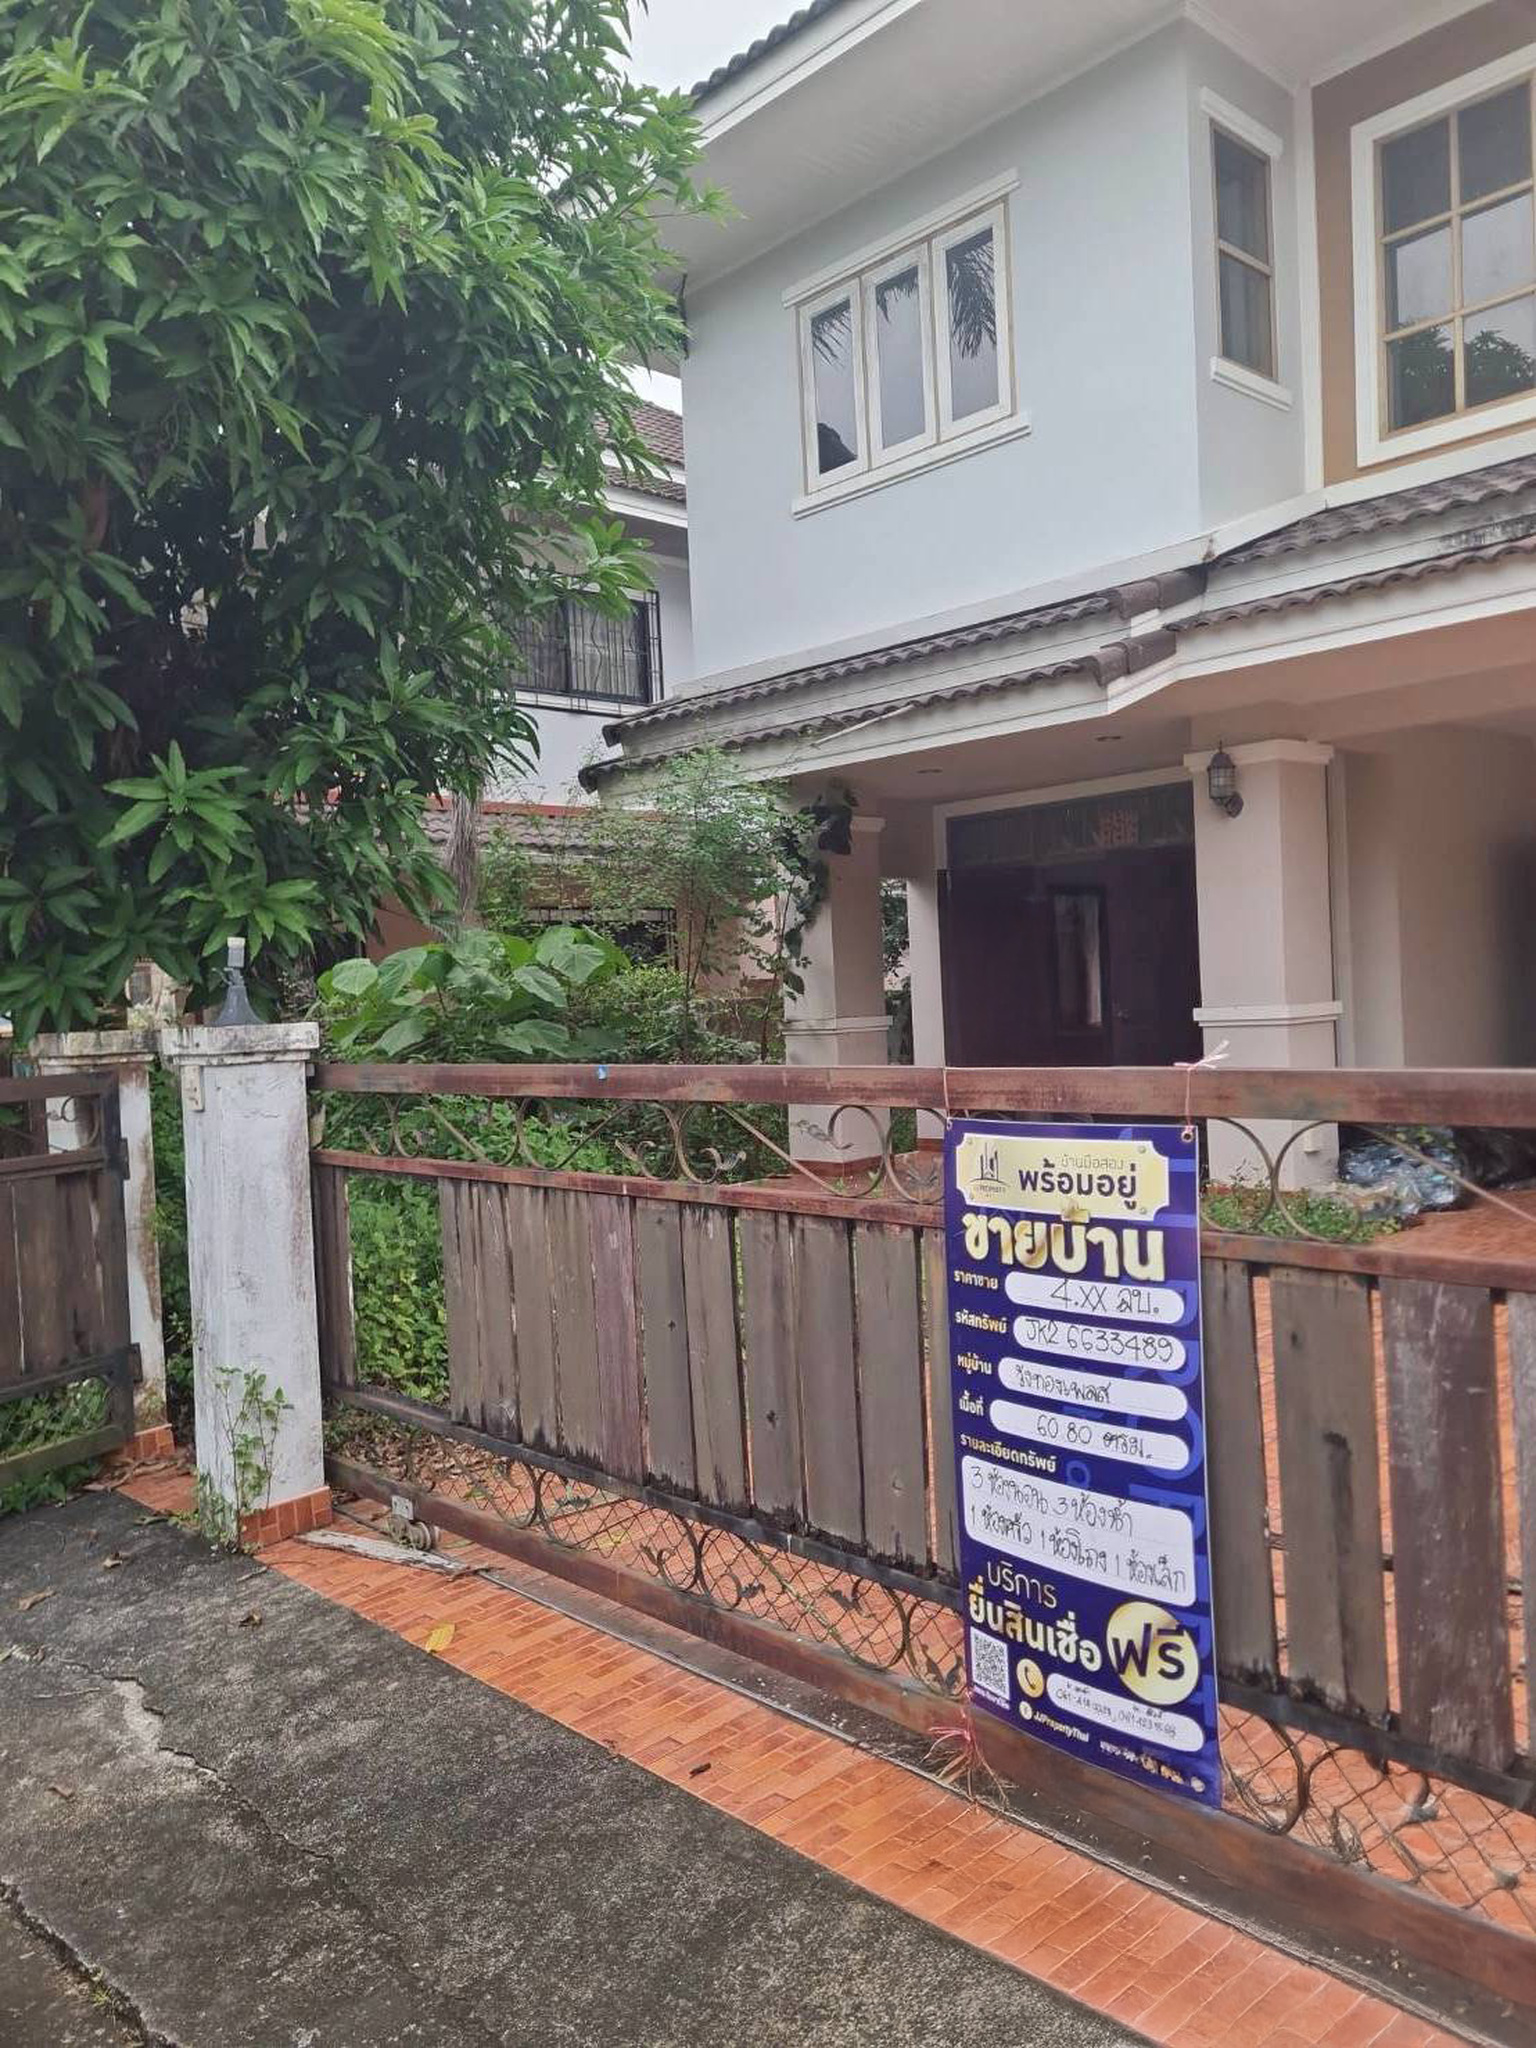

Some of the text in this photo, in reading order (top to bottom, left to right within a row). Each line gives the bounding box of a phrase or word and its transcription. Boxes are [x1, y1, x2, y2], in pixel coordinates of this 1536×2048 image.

[1061, 1154, 1124, 1170] บ้านมือสอง
[1018, 1158, 1137, 1210] พร้อมอยู่
[962, 1199, 1166, 1282] ขายบ้าน
[953, 1270, 998, 1290] ราคาขาย
[954, 1308, 1008, 1334] รหัสทรัพย์
[957, 1351, 993, 1375] หมู่บ้าน
[959, 1433, 1058, 1473] รายละเอียดทรัพย์
[986, 1560, 1058, 1609] บริการ
[968, 1575, 1186, 1681] ยื่นสินเชื่อ ฟรี
